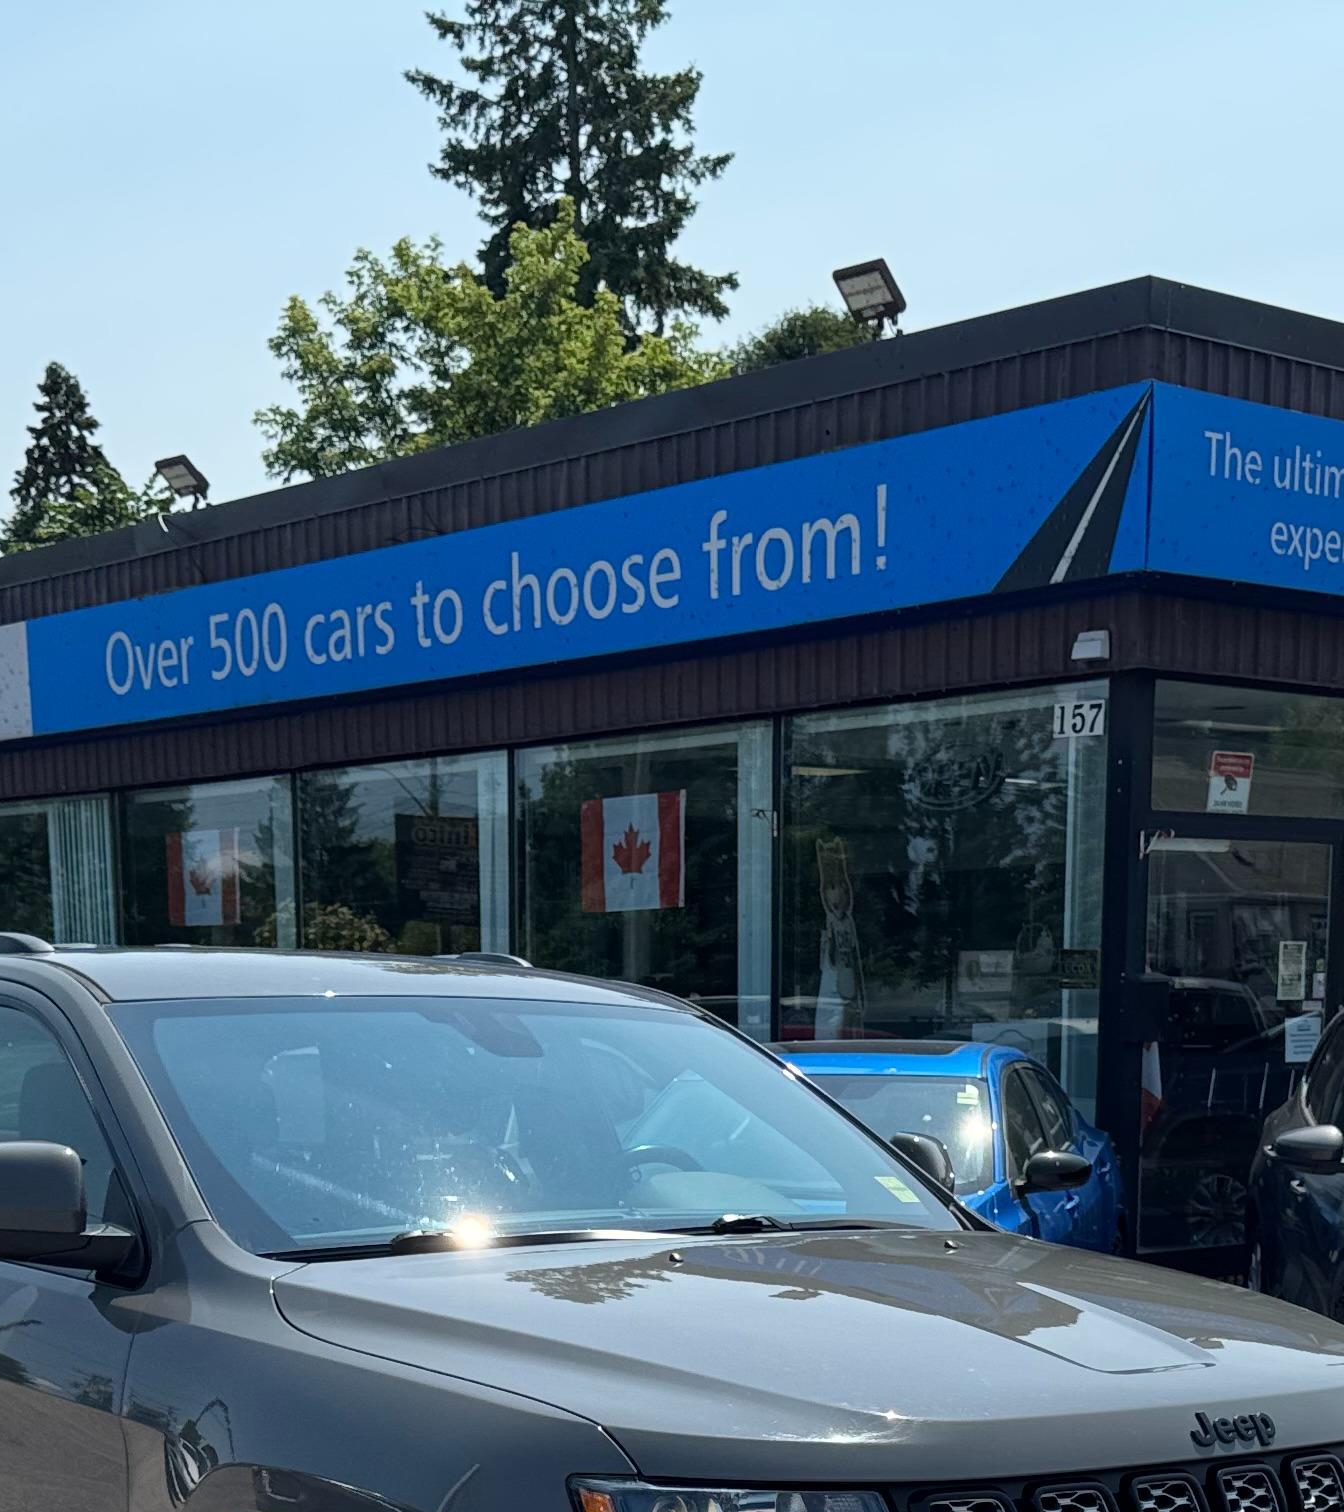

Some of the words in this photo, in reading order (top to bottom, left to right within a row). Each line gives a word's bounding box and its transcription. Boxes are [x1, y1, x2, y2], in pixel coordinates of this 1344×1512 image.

[1204, 430, 1263, 485] The
[105, 631, 194, 696] Over
[209, 602, 287, 681] 500
[304, 601, 395, 665] cars
[410, 580, 463, 648] to
[483, 547, 681, 636] choose
[702, 484, 887, 600] from!
[1057, 702, 1103, 735] 157
[1190, 1411, 1276, 1448] Jeep
